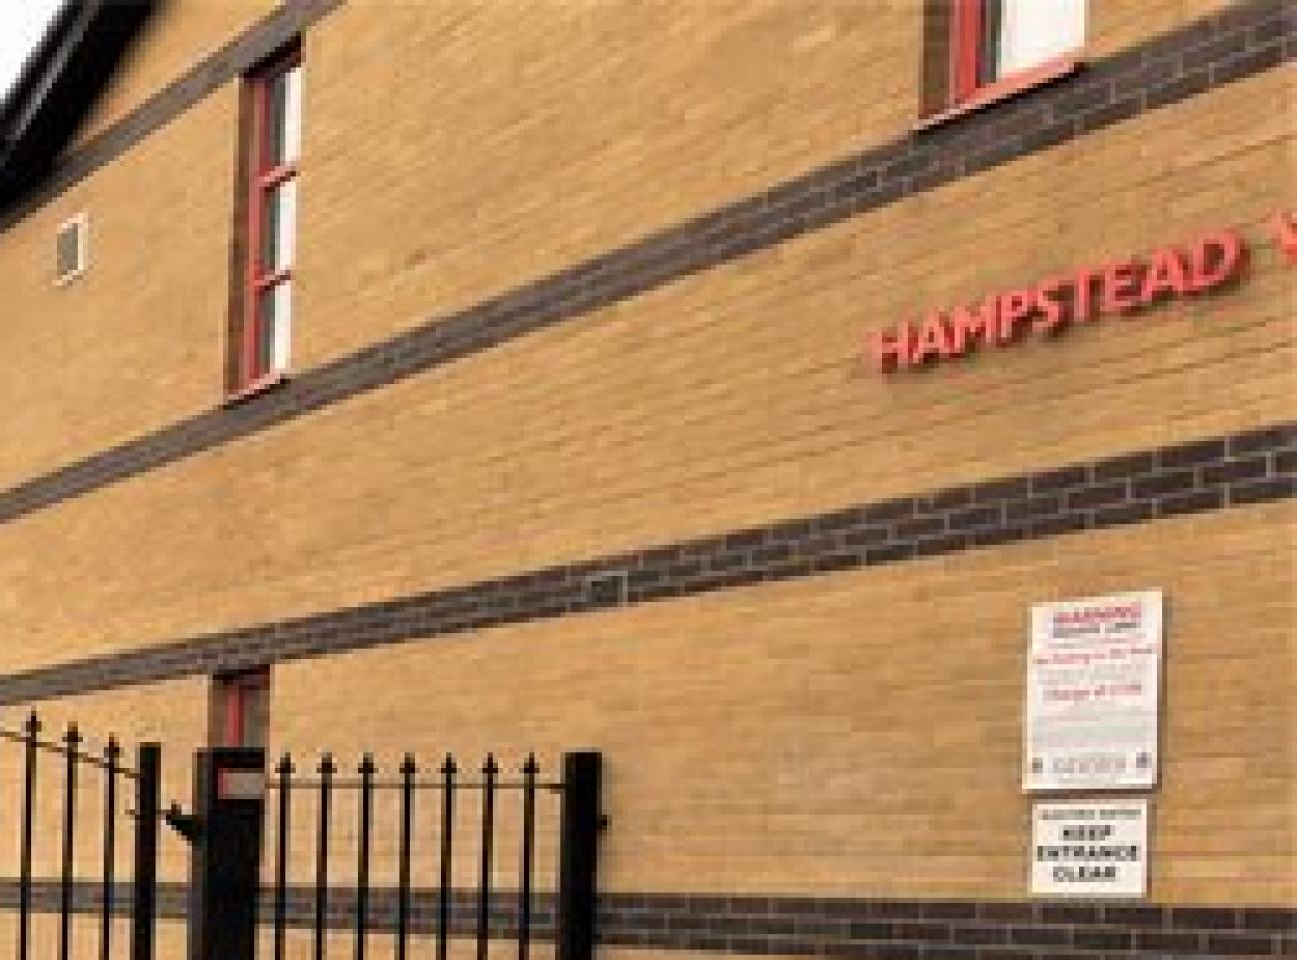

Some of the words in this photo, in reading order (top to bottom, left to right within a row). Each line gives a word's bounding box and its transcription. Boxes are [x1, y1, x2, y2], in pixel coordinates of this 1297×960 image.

[866, 228, 1250, 374] HAMPSTEAD
[1037, 845, 1141, 862] ENTRANCE
[1052, 866, 1119, 883] CLEAR
